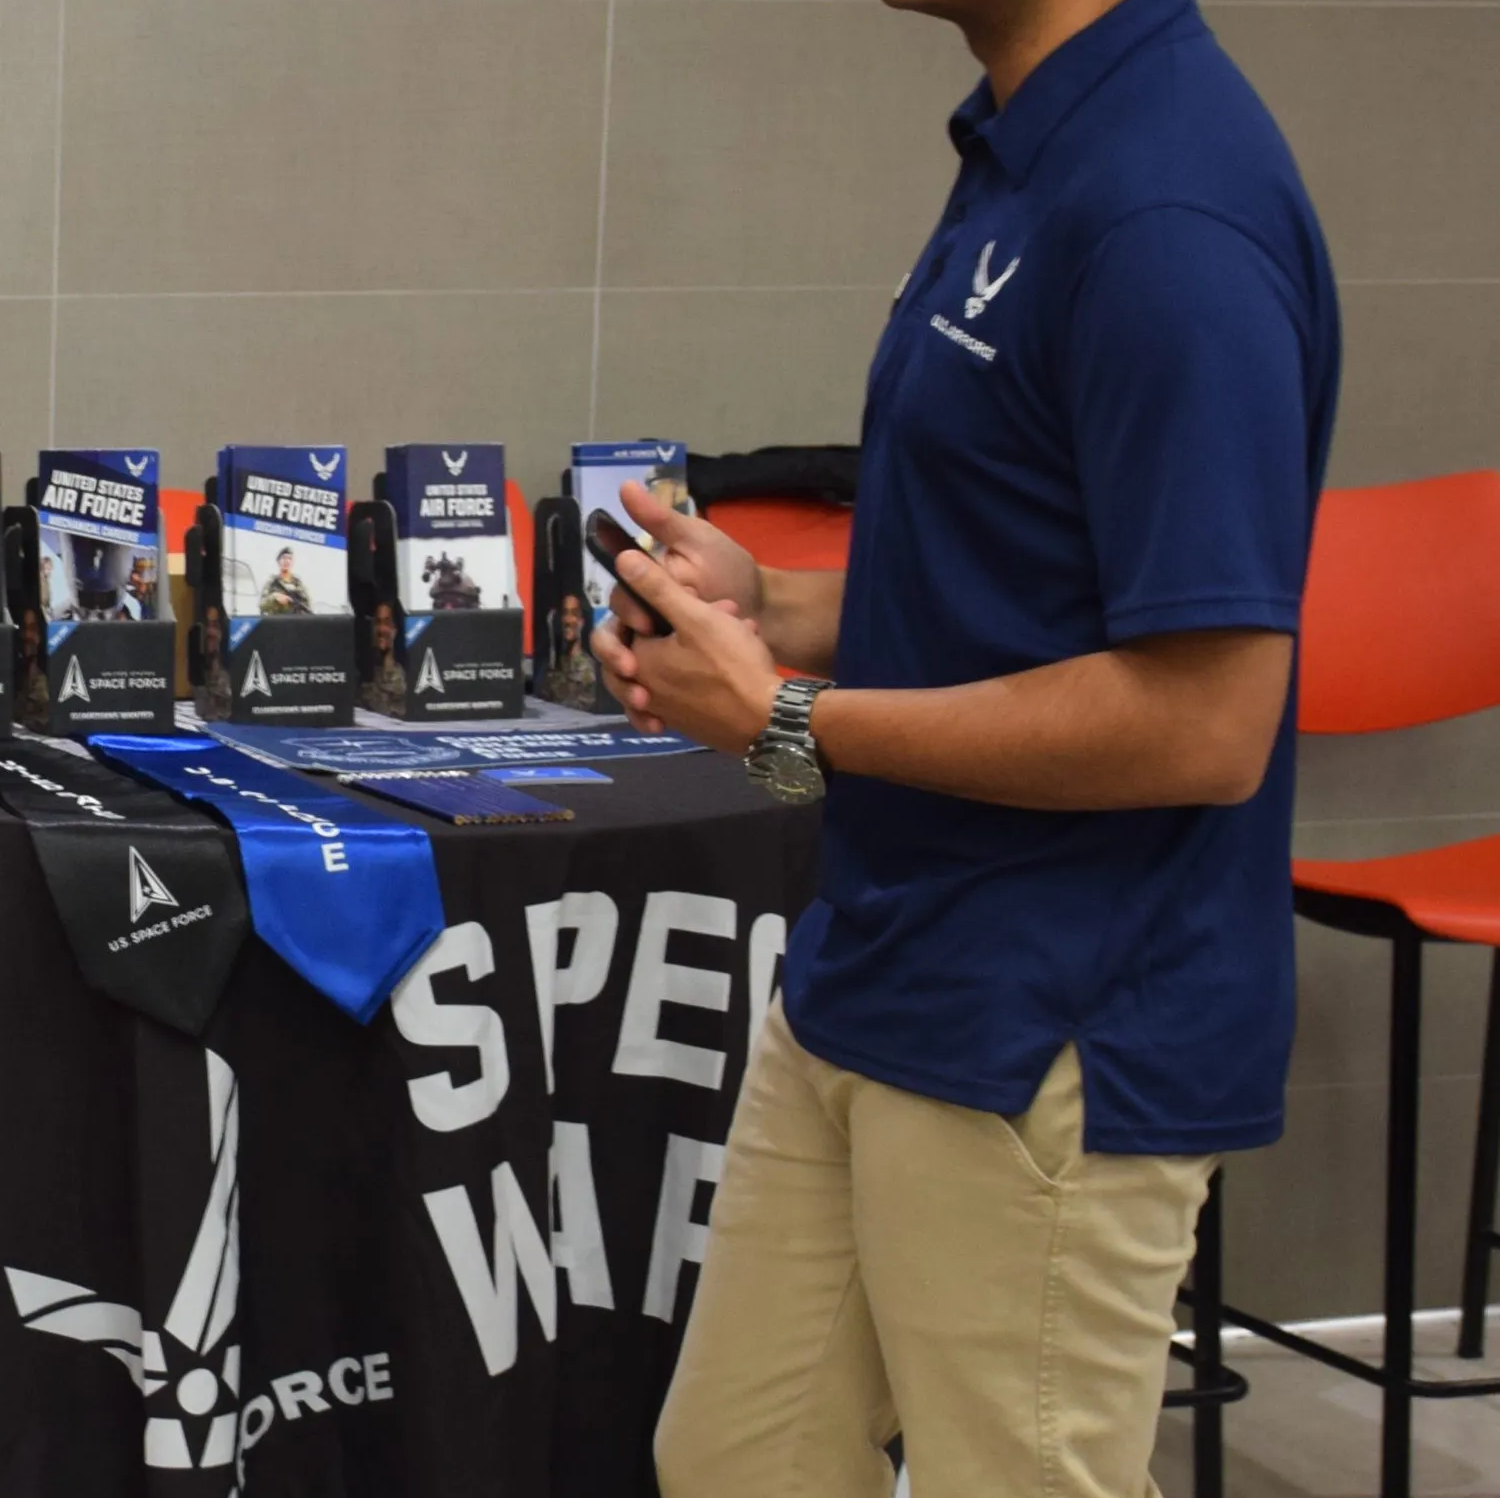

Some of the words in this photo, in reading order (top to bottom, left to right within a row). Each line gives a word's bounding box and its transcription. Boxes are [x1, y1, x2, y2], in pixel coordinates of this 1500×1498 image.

[51, 469, 98, 492] UNITED
[97, 479, 145, 502] STATES
[246, 475, 293, 497] UNITED
[292, 484, 339, 507] STATES
[41, 484, 78, 513] AIR
[79, 492, 146, 527] FORCE
[240, 491, 275, 517] AIR
[276, 498, 340, 531] FORCE
[420, 498, 445, 517] AIR
[446, 497, 495, 517] FORCE
[88, 678, 126, 689] SPACE
[128, 677, 167, 689] FORCE
[269, 673, 307, 684] SPACE
[308, 672, 346, 683] FORCE
[443, 669, 477, 681] SPACE
[478, 668, 514, 680] FORCE
[130, 920, 171, 945] SPACE
[171, 903, 214, 929] FORCE
